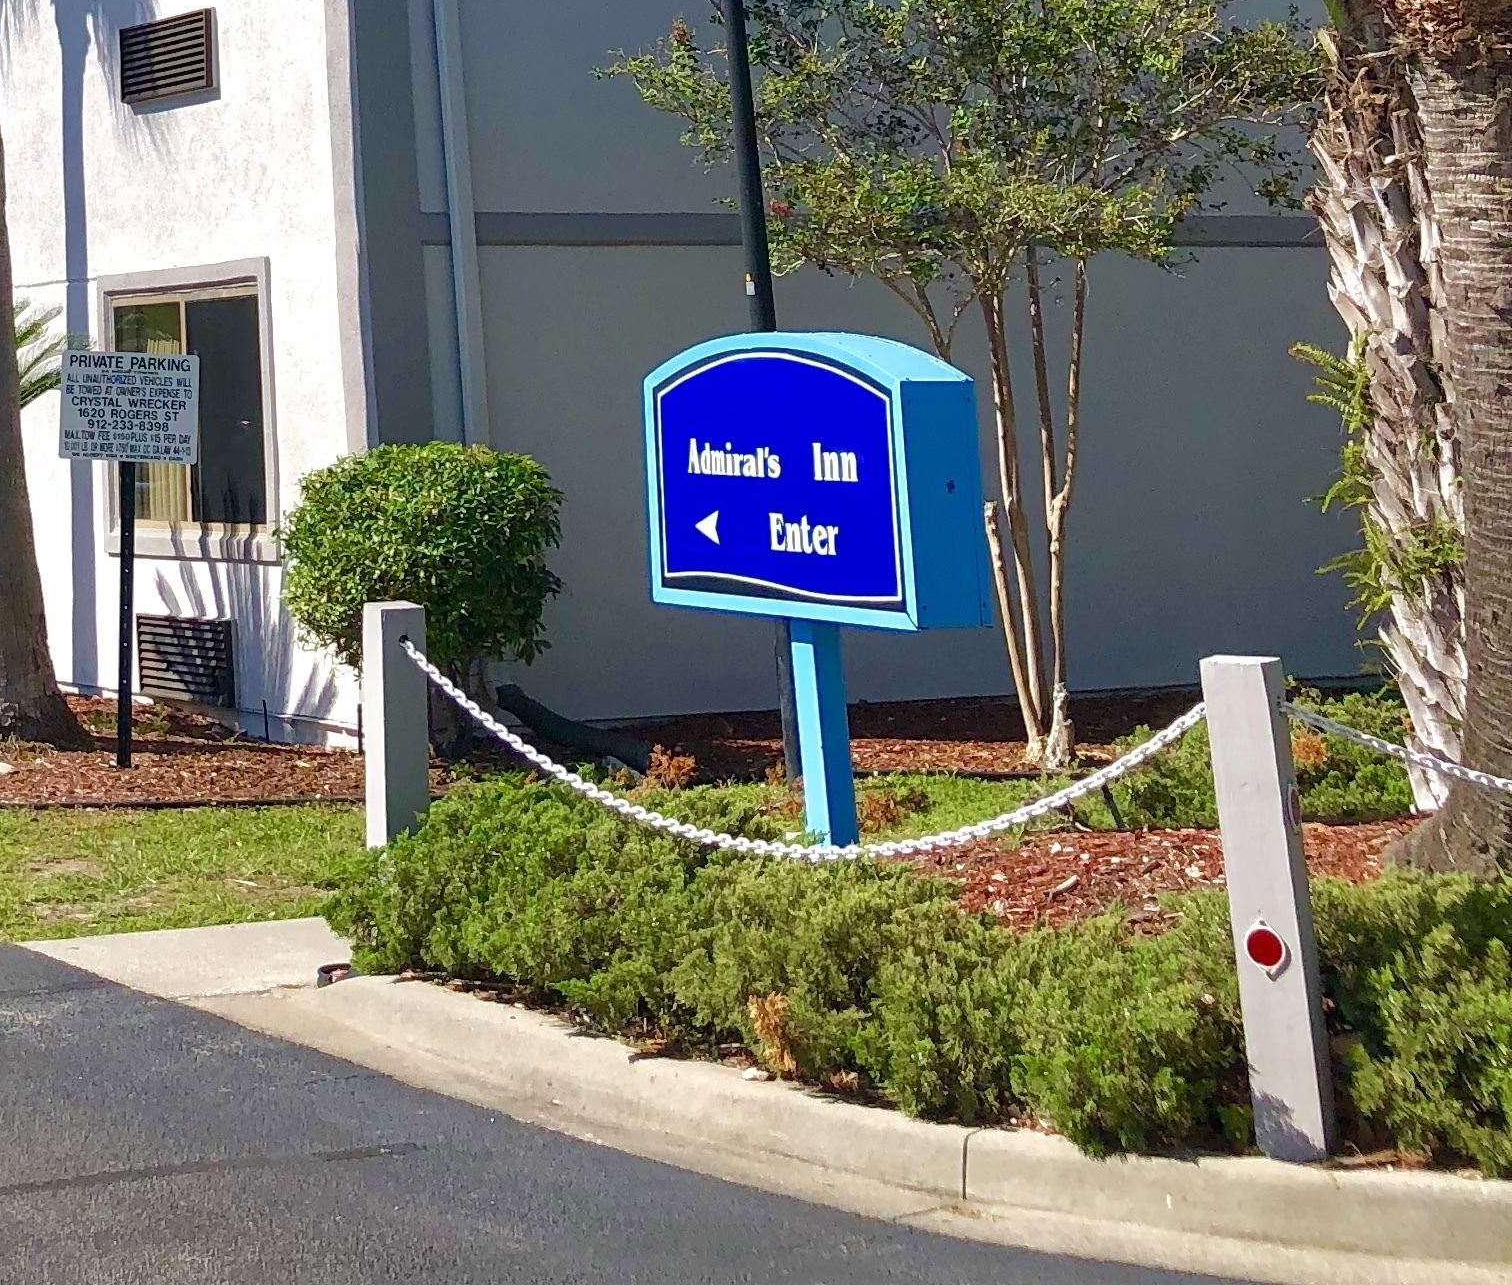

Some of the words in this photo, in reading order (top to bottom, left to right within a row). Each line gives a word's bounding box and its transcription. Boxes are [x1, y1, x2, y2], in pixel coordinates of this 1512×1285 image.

[70, 355, 124, 368] PRIVATE
[131, 357, 190, 372] PARKING
[67, 373, 79, 383] ALL
[83, 374, 137, 385] UNAUTHORIZED
[140, 376, 173, 386] VEHICLES
[176, 378, 192, 387] WILL
[66, 385, 75, 395] BE
[78, 385, 102, 396] TOWED
[105, 386, 113, 395] AT
[149, 388, 180, 399] EXPENSE
[184, 389, 193, 399] TO
[71, 396, 122, 407] CRYSTAL
[128, 398, 187, 410] WRECKER
[78, 408, 105, 418] 1620
[111, 409, 158, 420] ROGERS
[164, 411, 179, 421] ST
[88, 419, 169, 432] 912-233-8398
[98, 431, 110, 441] FEE
[164, 434, 177, 444] PER
[179, 434, 191, 444] DAY
[688, 438, 781, 479] Admiral's
[812, 442, 858, 482] Inn
[768, 512, 839, 556] Enter
